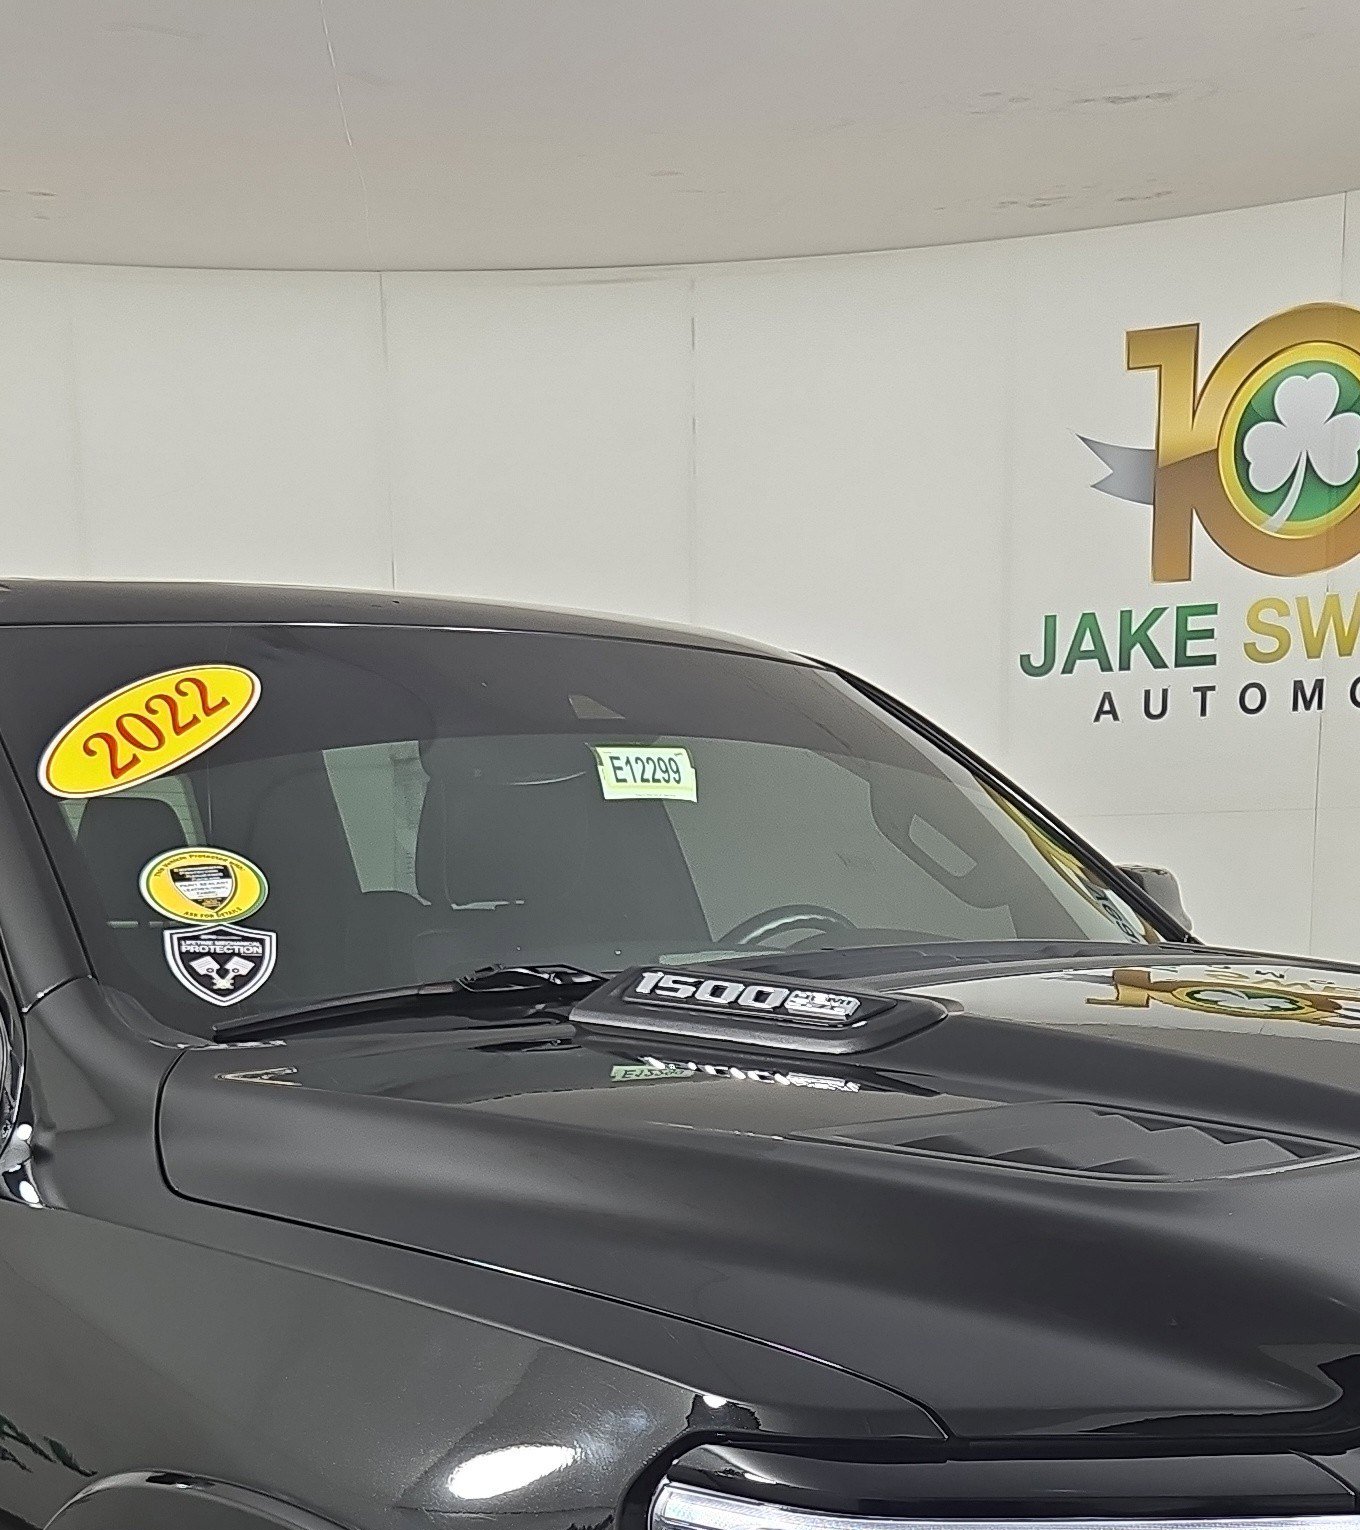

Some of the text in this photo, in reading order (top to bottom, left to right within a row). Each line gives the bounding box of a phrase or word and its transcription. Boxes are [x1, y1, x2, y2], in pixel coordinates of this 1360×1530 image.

[1019, 602, 1219, 678] JAKE
[83, 677, 230, 779] 2022
[608, 755, 682, 784] E12299
[189, 854, 228, 863] Protected
[181, 945, 262, 953] PROTECTION
[636, 971, 790, 1009] 1500
